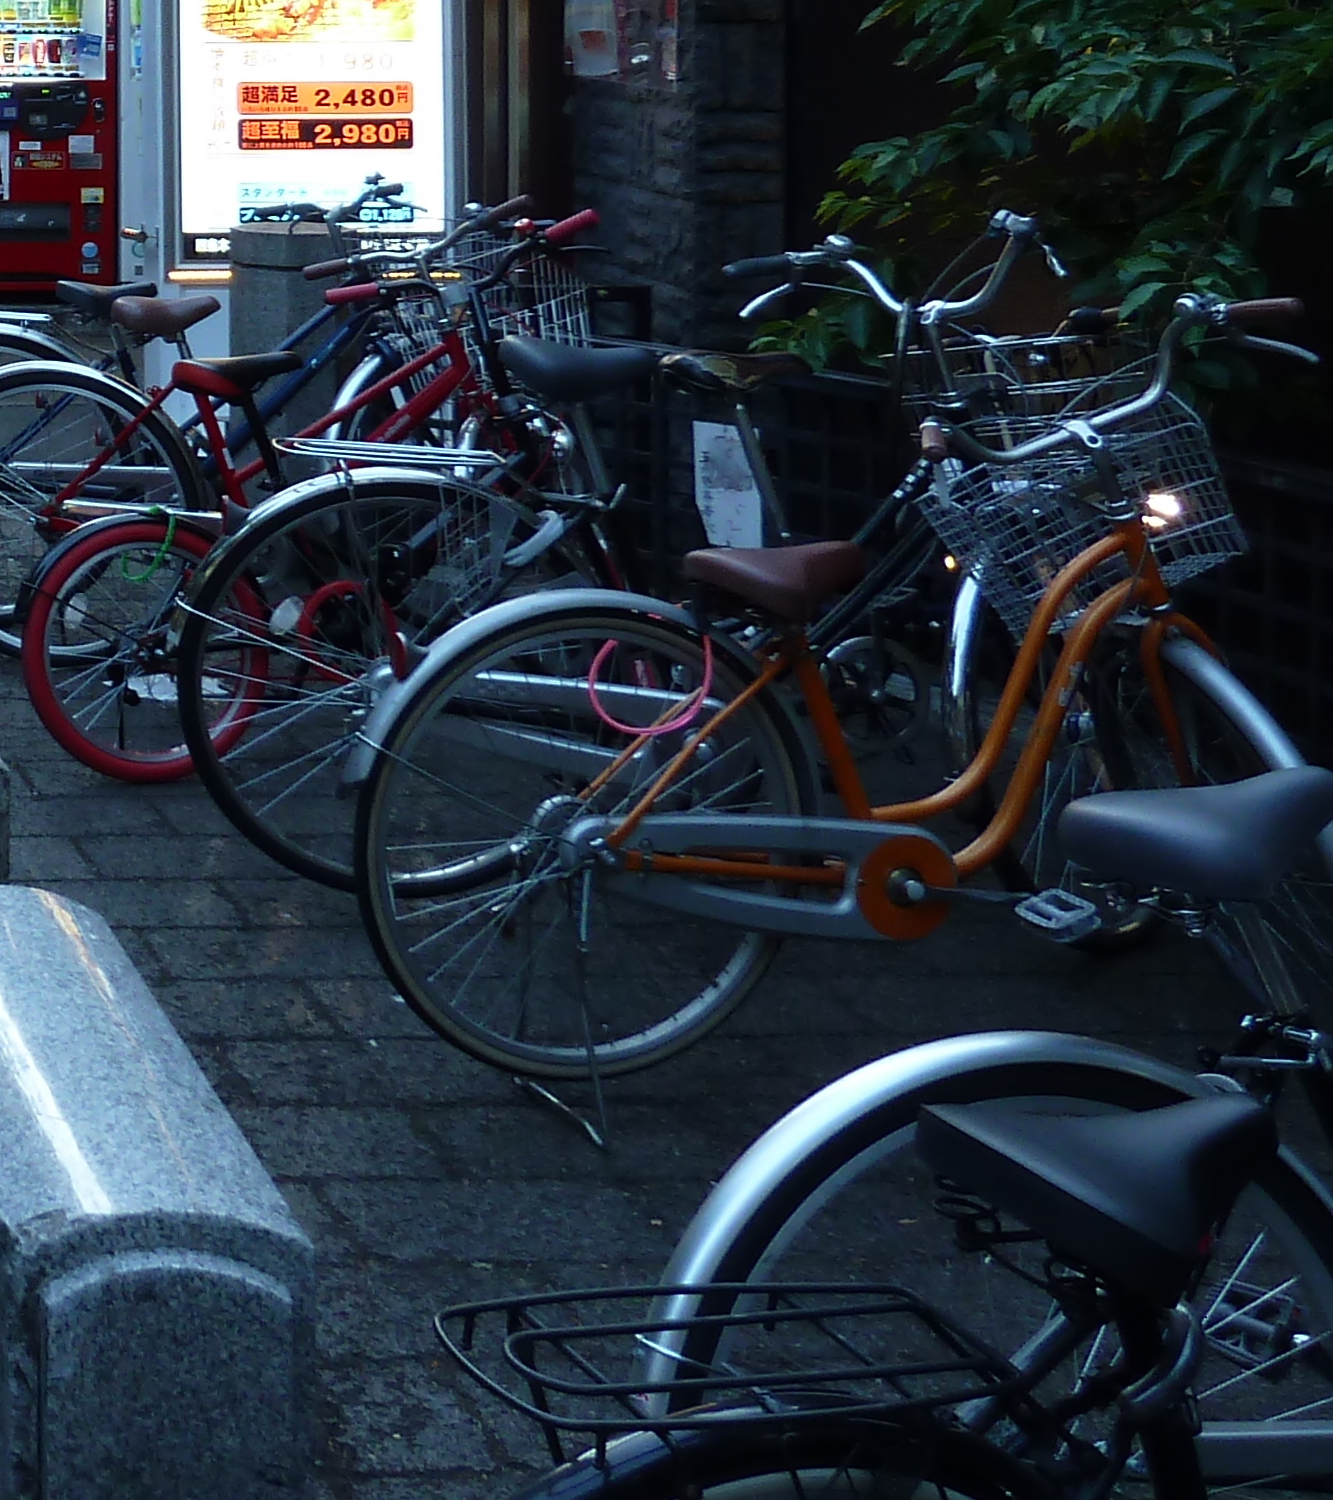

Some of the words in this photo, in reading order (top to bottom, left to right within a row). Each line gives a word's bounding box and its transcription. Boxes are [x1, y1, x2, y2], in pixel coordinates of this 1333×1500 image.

[242, 85, 298, 104] 超満足
[314, 88, 395, 108] 2,480
[242, 121, 299, 140] 超至福
[314, 124, 396, 146] 2,980
